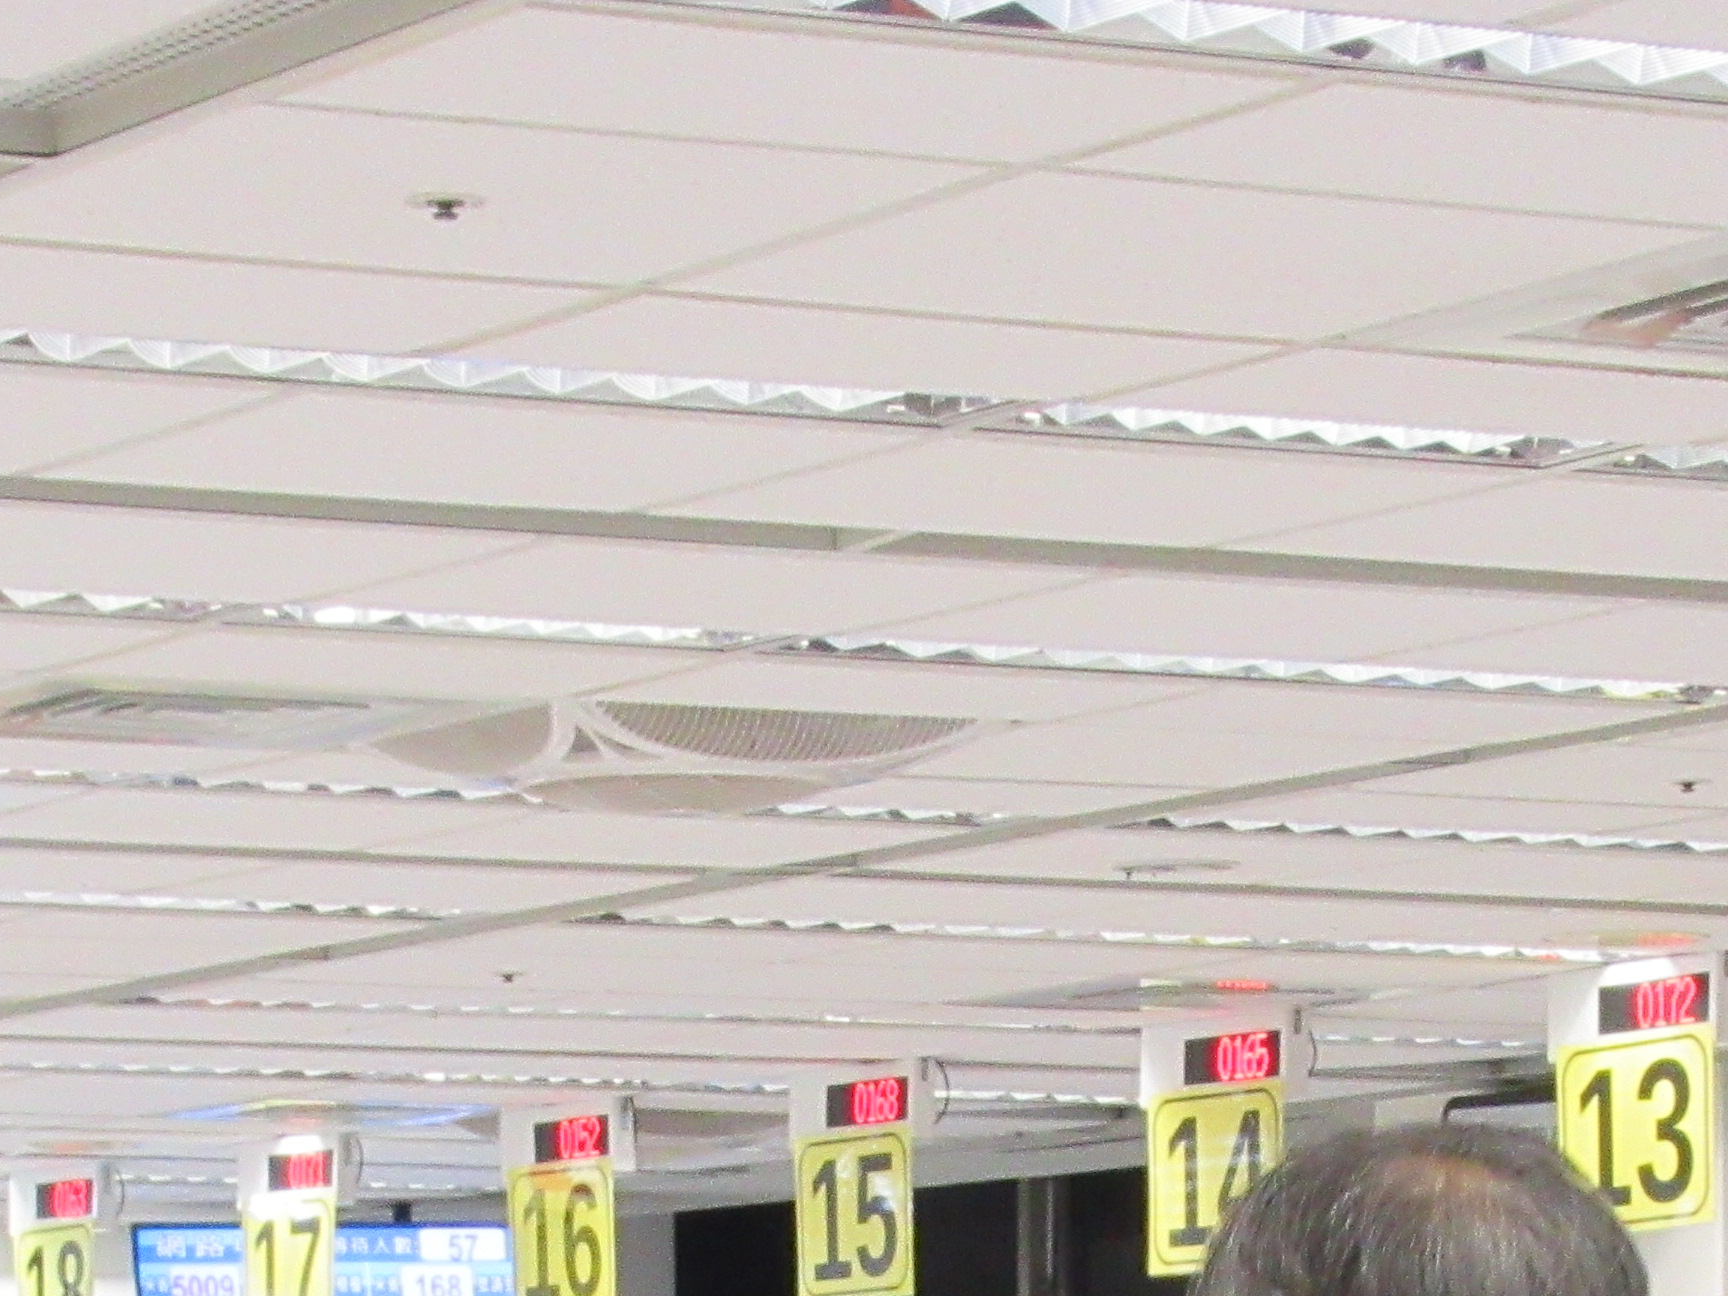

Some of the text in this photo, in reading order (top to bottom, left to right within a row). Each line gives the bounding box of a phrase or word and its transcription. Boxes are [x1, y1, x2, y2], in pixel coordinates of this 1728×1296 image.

[1637, 975, 1697, 1029] 0172
[1217, 1032, 1270, 1082] 0165
[854, 1078, 899, 1124] 0168
[1580, 1057, 1694, 1206] 13
[813, 1152, 898, 1281] 15
[449, 1234, 478, 1261] 57
